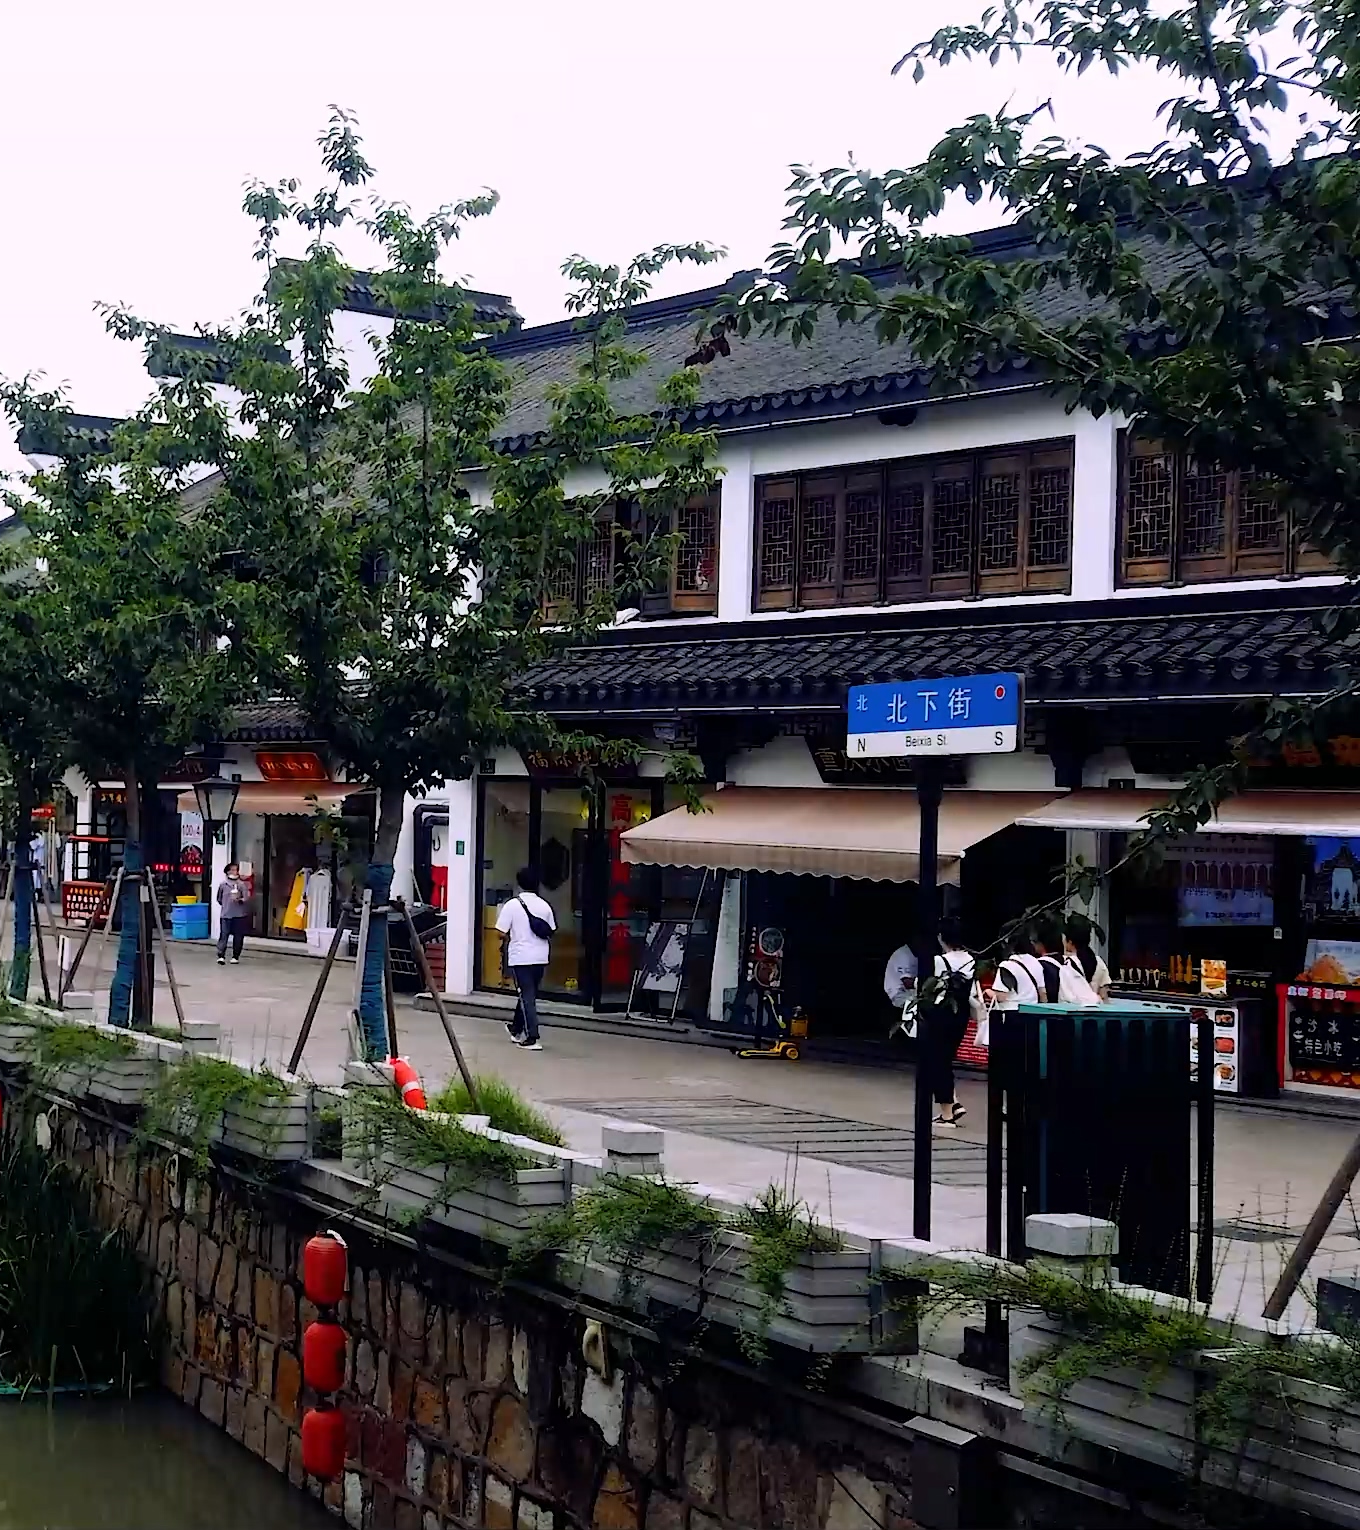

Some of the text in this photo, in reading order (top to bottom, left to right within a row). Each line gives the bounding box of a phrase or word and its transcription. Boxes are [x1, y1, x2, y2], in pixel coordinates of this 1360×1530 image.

[855, 694, 868, 711] 北
[886, 687, 972, 724] 北下街
[857, 738, 866, 752] N
[905, 735, 932, 747] Beixia
[994, 731, 1003, 746] S
